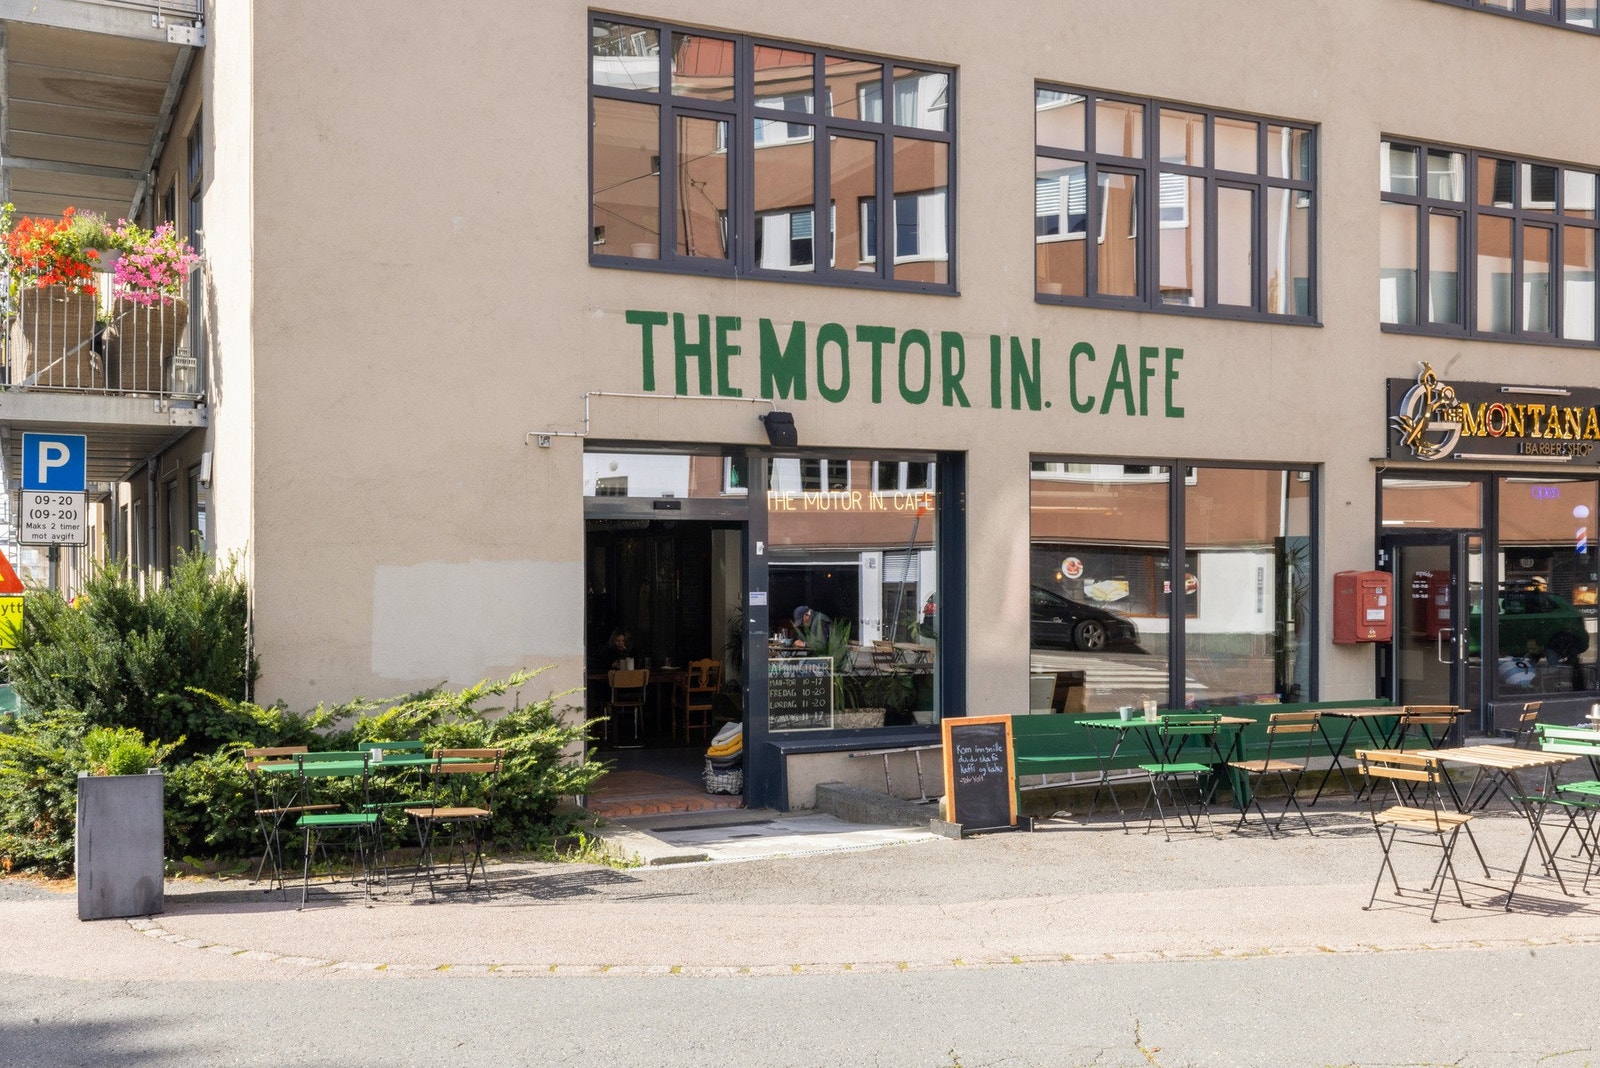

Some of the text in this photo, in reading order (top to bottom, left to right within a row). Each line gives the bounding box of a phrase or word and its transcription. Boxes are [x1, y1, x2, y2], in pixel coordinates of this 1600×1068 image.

[626, 310, 1185, 418] THE MOTOR IN. CAFE
[1461, 402, 1600, 440] MONTANA
[38, 441, 71, 483] P
[767, 491, 797, 511] THE
[805, 491, 862, 511] MOTOR
[894, 491, 935, 511] CAFE
[25, 522, 80, 531] Maks 2 timer
[31, 532, 75, 543] mot avgift
[770, 689, 797, 698] FREDAG
[956, 744, 972, 754] Kom
